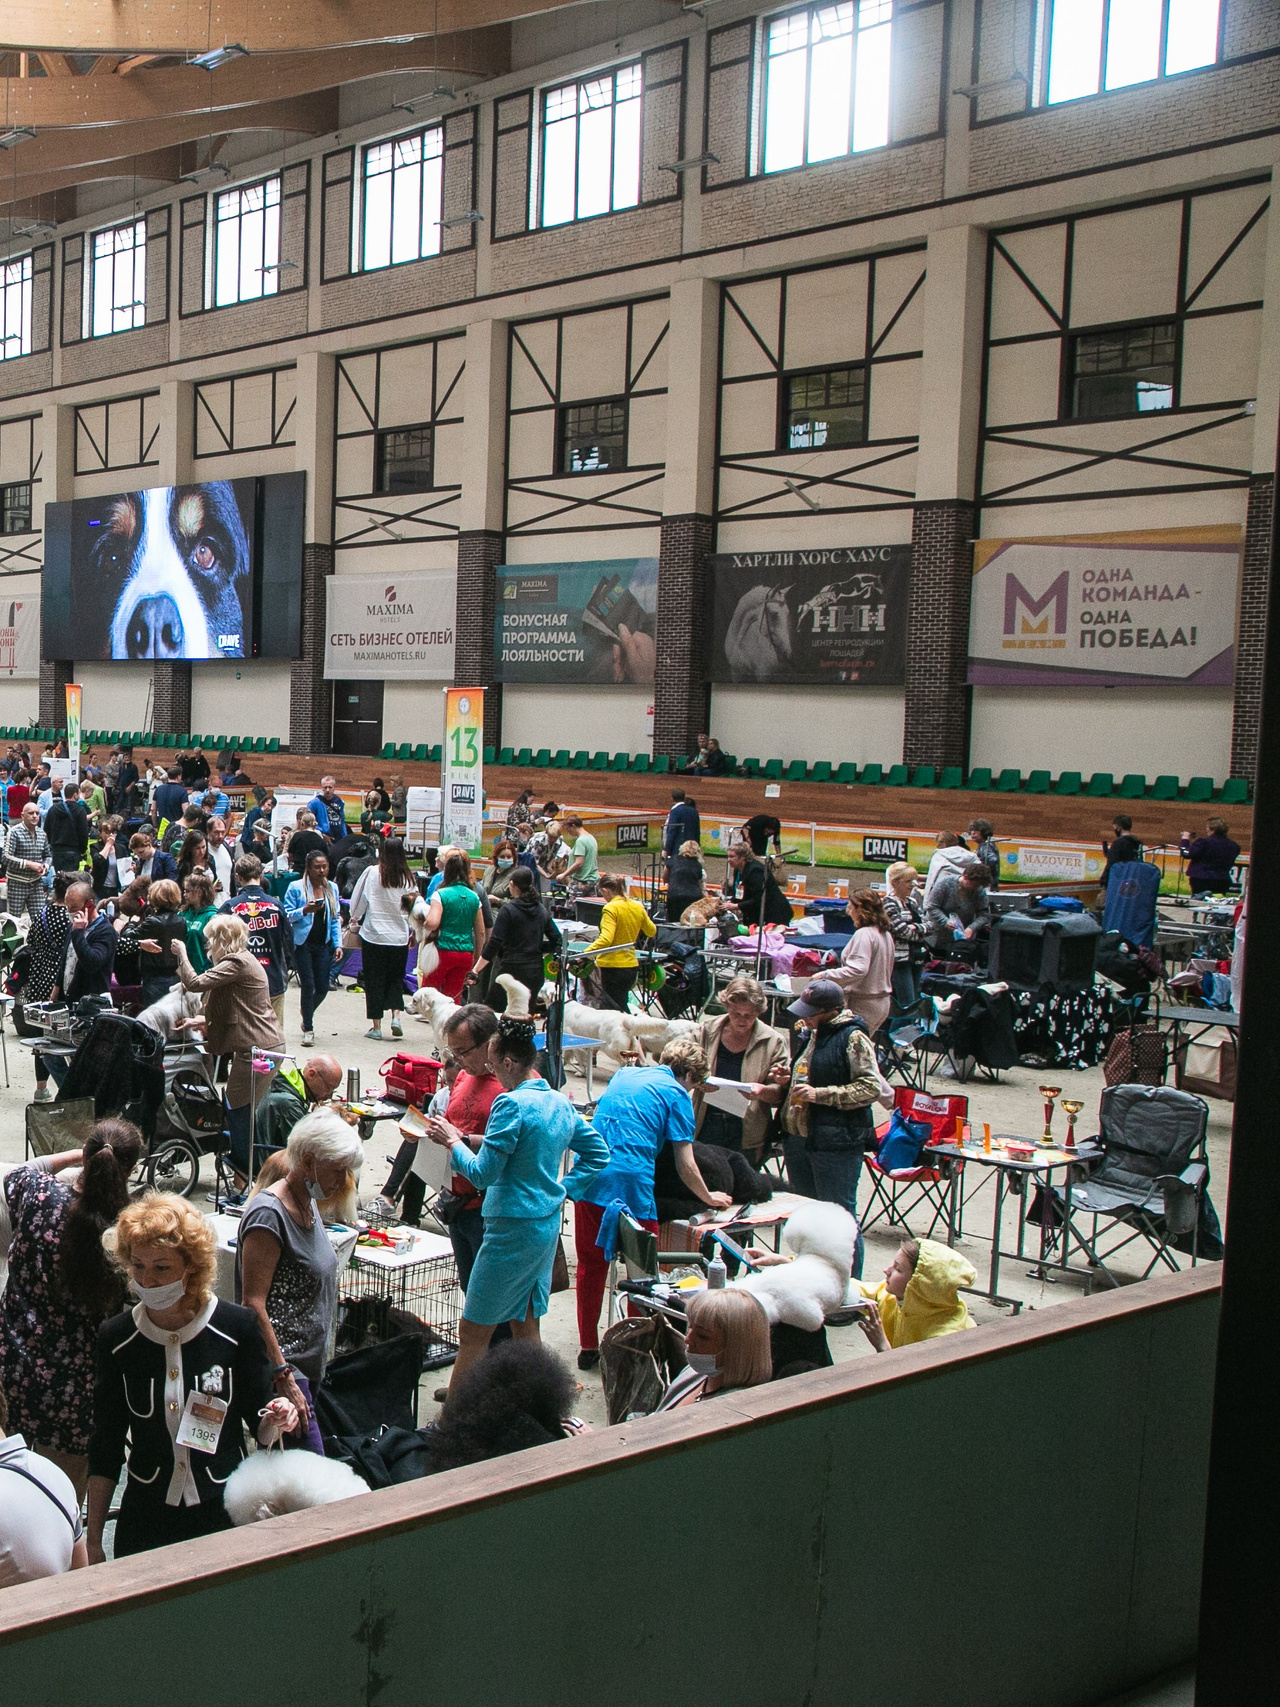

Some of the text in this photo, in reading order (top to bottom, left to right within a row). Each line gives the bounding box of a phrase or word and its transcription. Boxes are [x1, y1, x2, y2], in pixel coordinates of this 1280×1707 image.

[732, 547, 891, 568] ХАРТЛИ ХОРС ХАУС
[1082, 568, 1134, 584] ОДНА
[521, 580, 547, 588] MAXIMA
[1082, 583, 1191, 603] КОМАНДА
[366, 604, 414, 616] MAXIMA
[503, 614, 568, 627] БОНУСНАЯ
[1080, 610, 1132, 625] ОДНА
[330, 628, 453, 646] СЕТЬ БИЗНЕС ОТЕЛЕЙ
[502, 632, 577, 644] ПРОГРАММА
[834, 639, 884, 648] РЕПРОДУКЦИИ
[1014, 640, 1055, 648] TEAM
[1080, 627, 1197, 649] ПОБЕДА!
[354, 651, 426, 660] MAXIMAHOTELS.RU
[501, 650, 584, 662] ЛОЯЛЬНОСТИ
[829, 649, 865, 658] ЛОШАДЕЙ
[450, 726, 479, 768] 13
[451, 772, 476, 781] RING
[452, 786, 475, 800] CRAVE
[618, 825, 647, 843] CRAVE
[865, 838, 906, 858] CRAVE
[1023, 854, 1082, 867] MAZOVER
[255, 913, 279, 930] Bull
[191, 1427, 216, 1443] 1395
